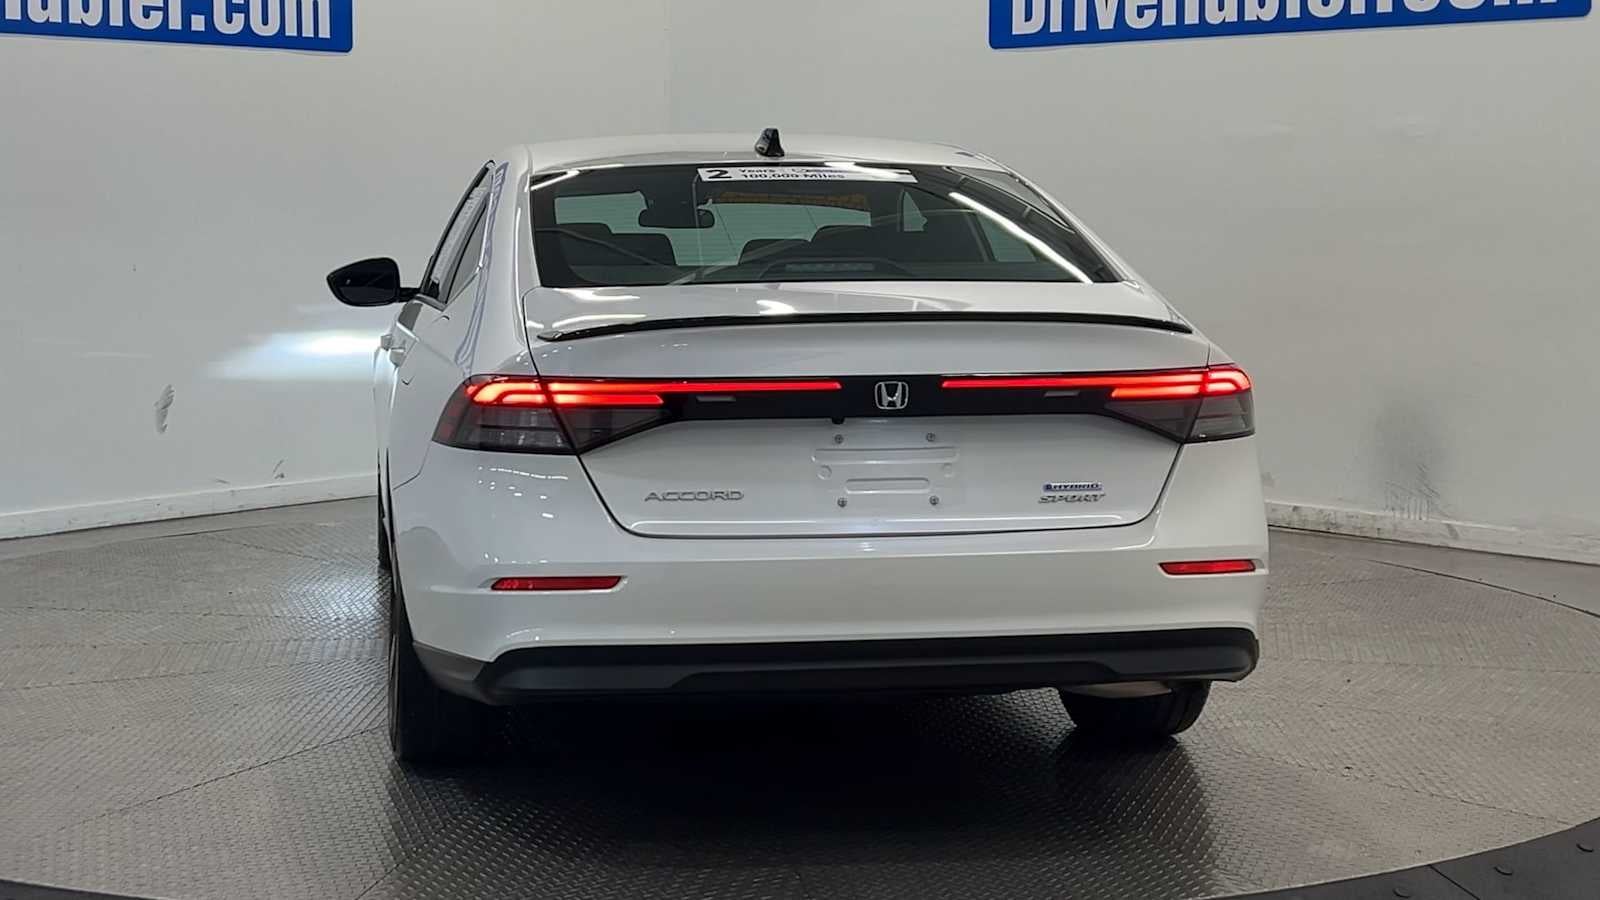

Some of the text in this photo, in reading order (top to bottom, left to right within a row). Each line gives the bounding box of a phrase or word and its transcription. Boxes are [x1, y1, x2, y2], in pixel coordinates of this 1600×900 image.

[706, 169, 732, 179] 2
[644, 491, 744, 502] ACCORD
[1038, 493, 1105, 504] SPORT
